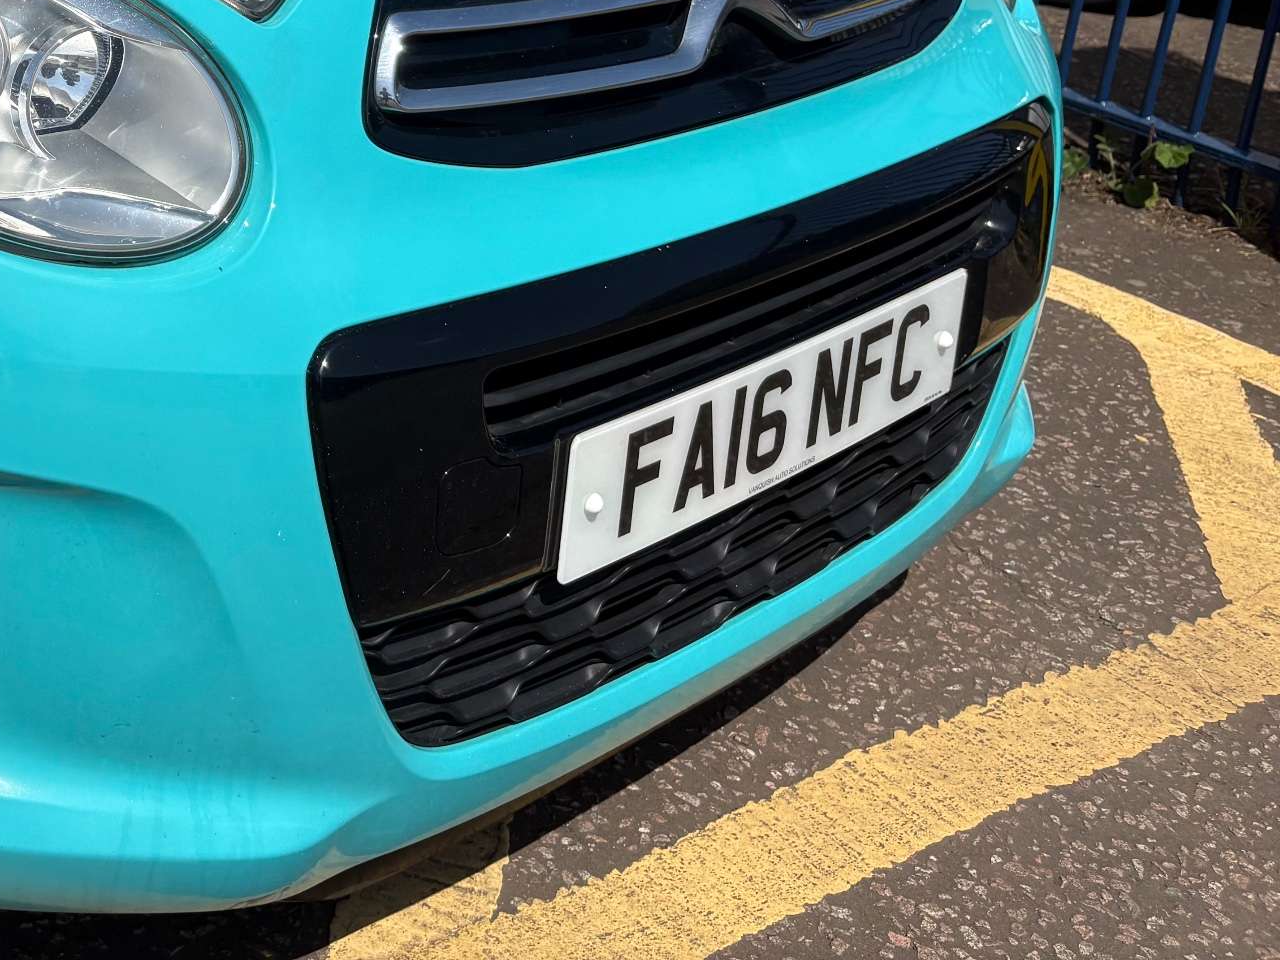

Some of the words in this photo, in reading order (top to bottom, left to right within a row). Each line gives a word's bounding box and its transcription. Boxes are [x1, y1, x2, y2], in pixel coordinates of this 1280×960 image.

[617, 368, 793, 538] FA16
[805, 303, 930, 449] NFC
[789, 455, 816, 474] SOLUTIONS
